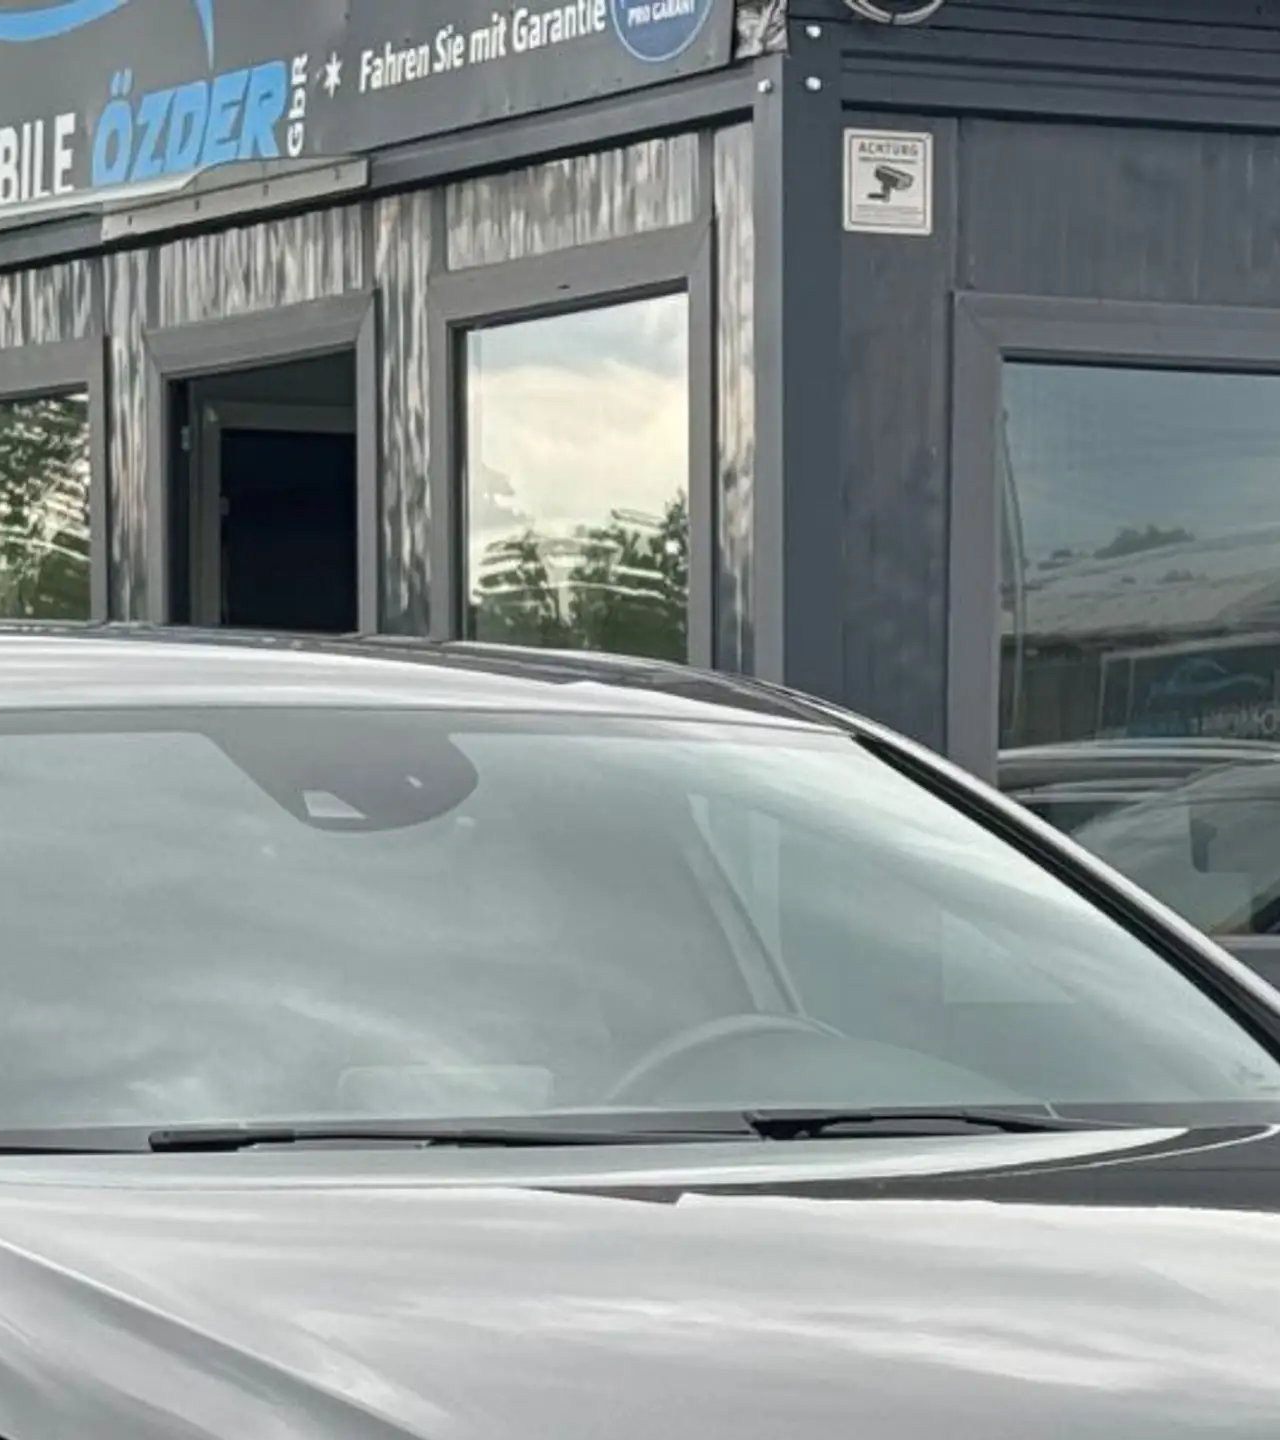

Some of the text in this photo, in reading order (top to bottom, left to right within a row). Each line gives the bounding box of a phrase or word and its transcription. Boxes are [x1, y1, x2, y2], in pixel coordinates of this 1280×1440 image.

[359, 0, 607, 93] Fahren Sie mit Garantie
[92, 60, 287, 188] ÖZDER
[287, 53, 309, 158] GbR
